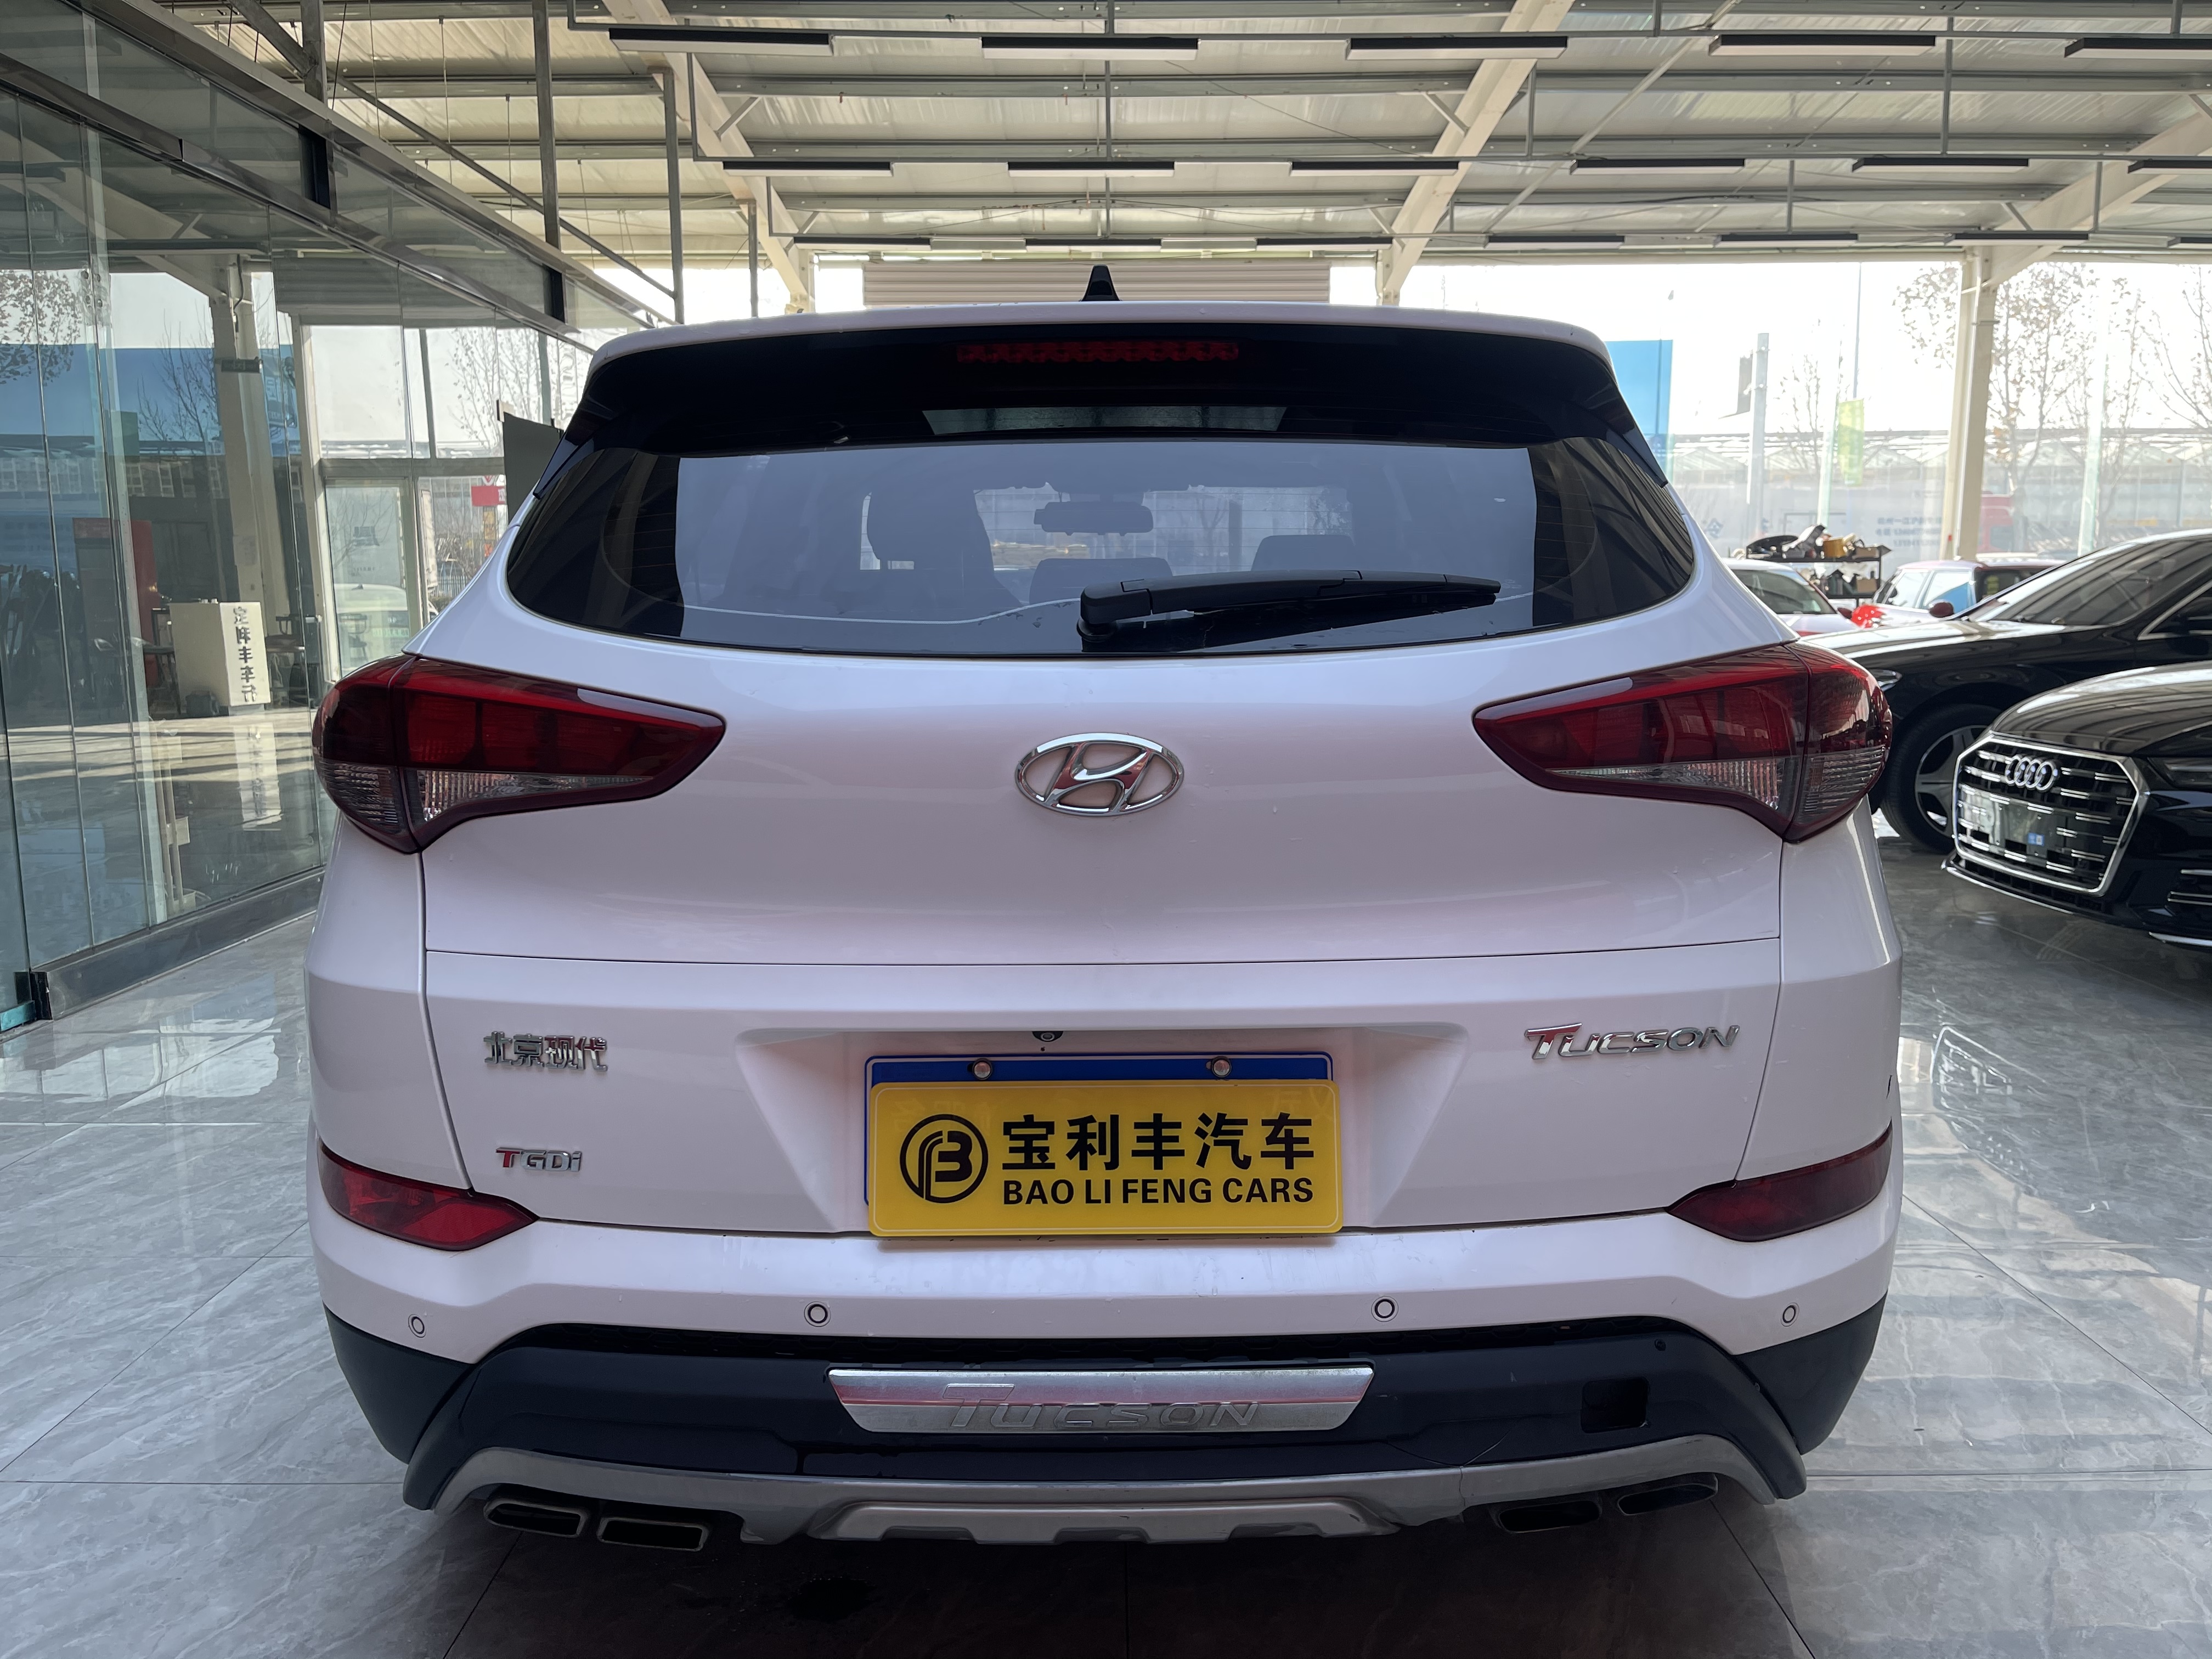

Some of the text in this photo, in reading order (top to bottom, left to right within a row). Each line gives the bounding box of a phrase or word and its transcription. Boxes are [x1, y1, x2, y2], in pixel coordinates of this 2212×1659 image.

[483, 1031, 608, 1071] 北京现代
[1525, 1023, 1740, 1060] TUCSON
[1002, 1113, 1314, 1170] 宝利丰汽车
[1003, 1177, 1314, 1204] BAO LI FENG CARS
[942, 1383, 1260, 1427] TUCSON
